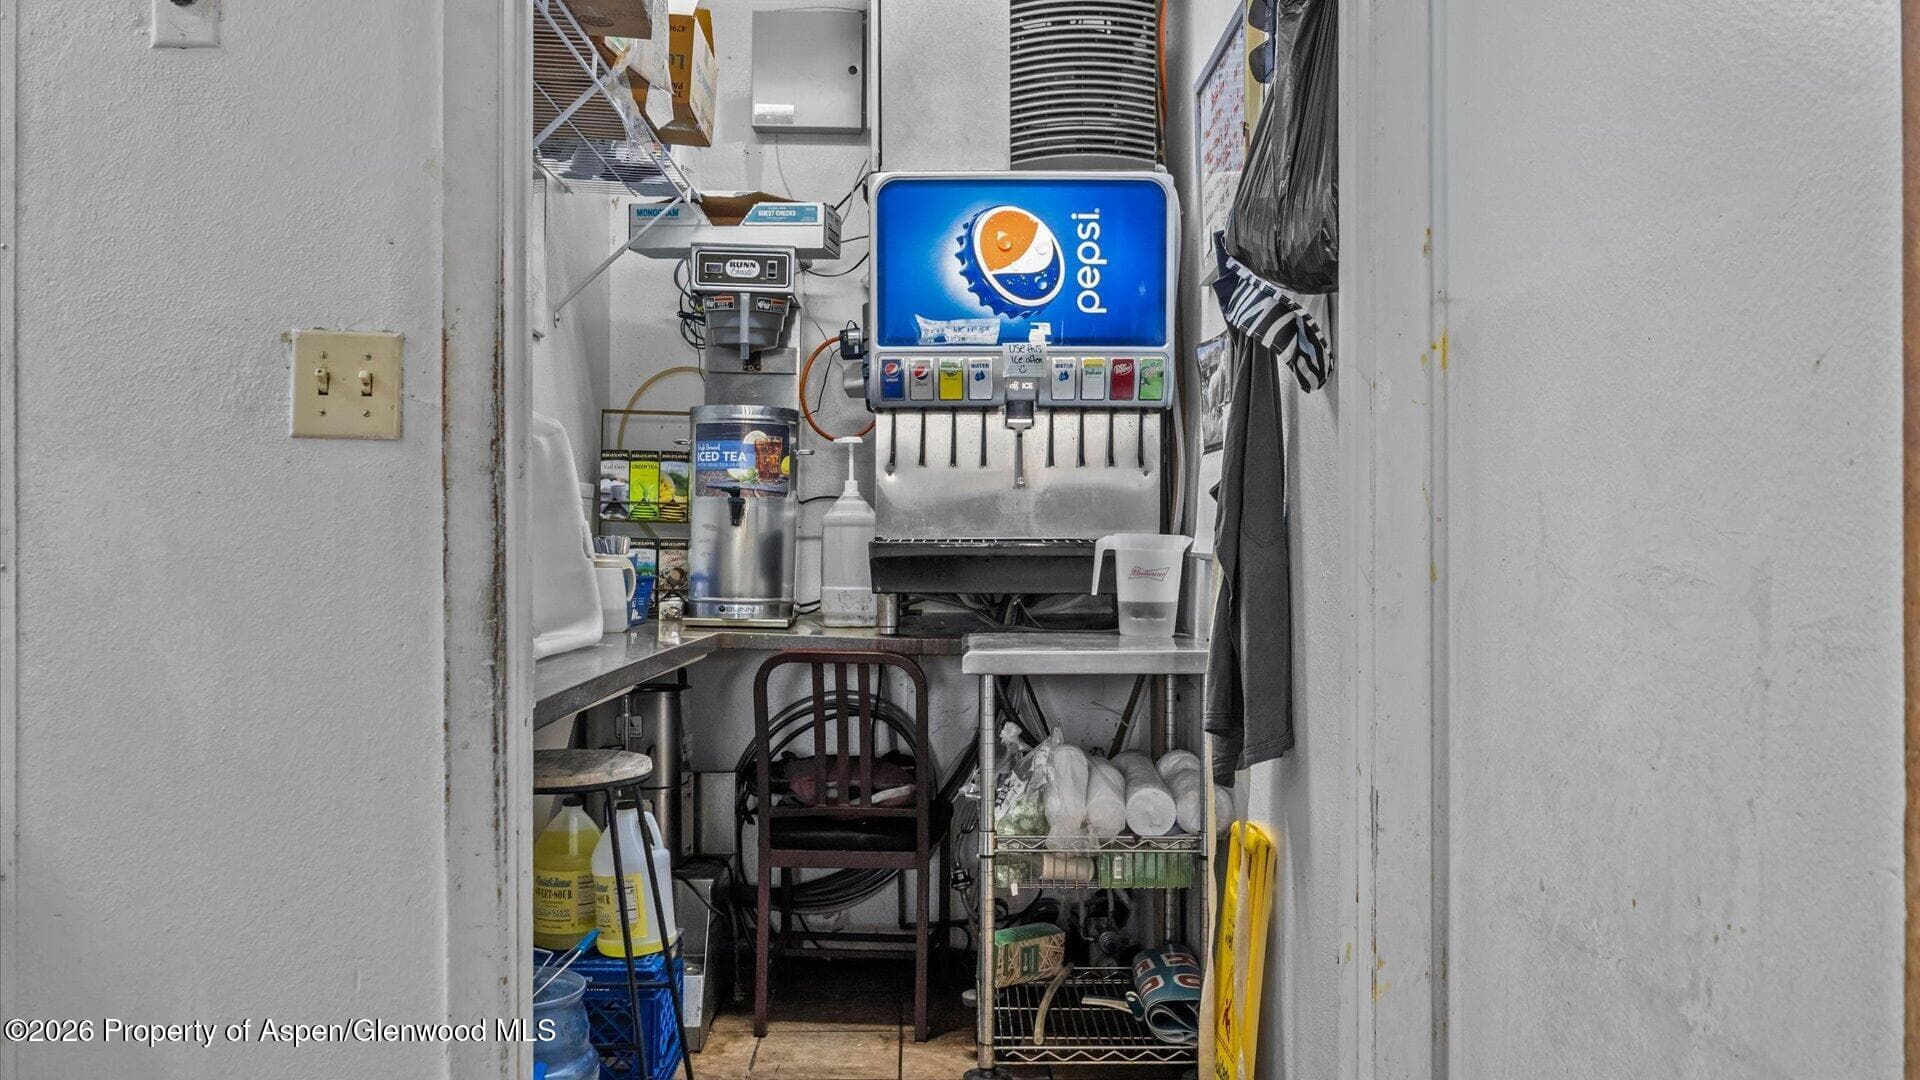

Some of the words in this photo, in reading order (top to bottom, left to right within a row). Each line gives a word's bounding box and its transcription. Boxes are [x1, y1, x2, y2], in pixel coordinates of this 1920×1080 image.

[729, 261, 757, 269] BUNN
[1071, 207, 1107, 314] pepsi
[1022, 382, 1034, 390] ICE
[697, 451, 720, 462] ICED
[722, 451, 747, 462] TEA
